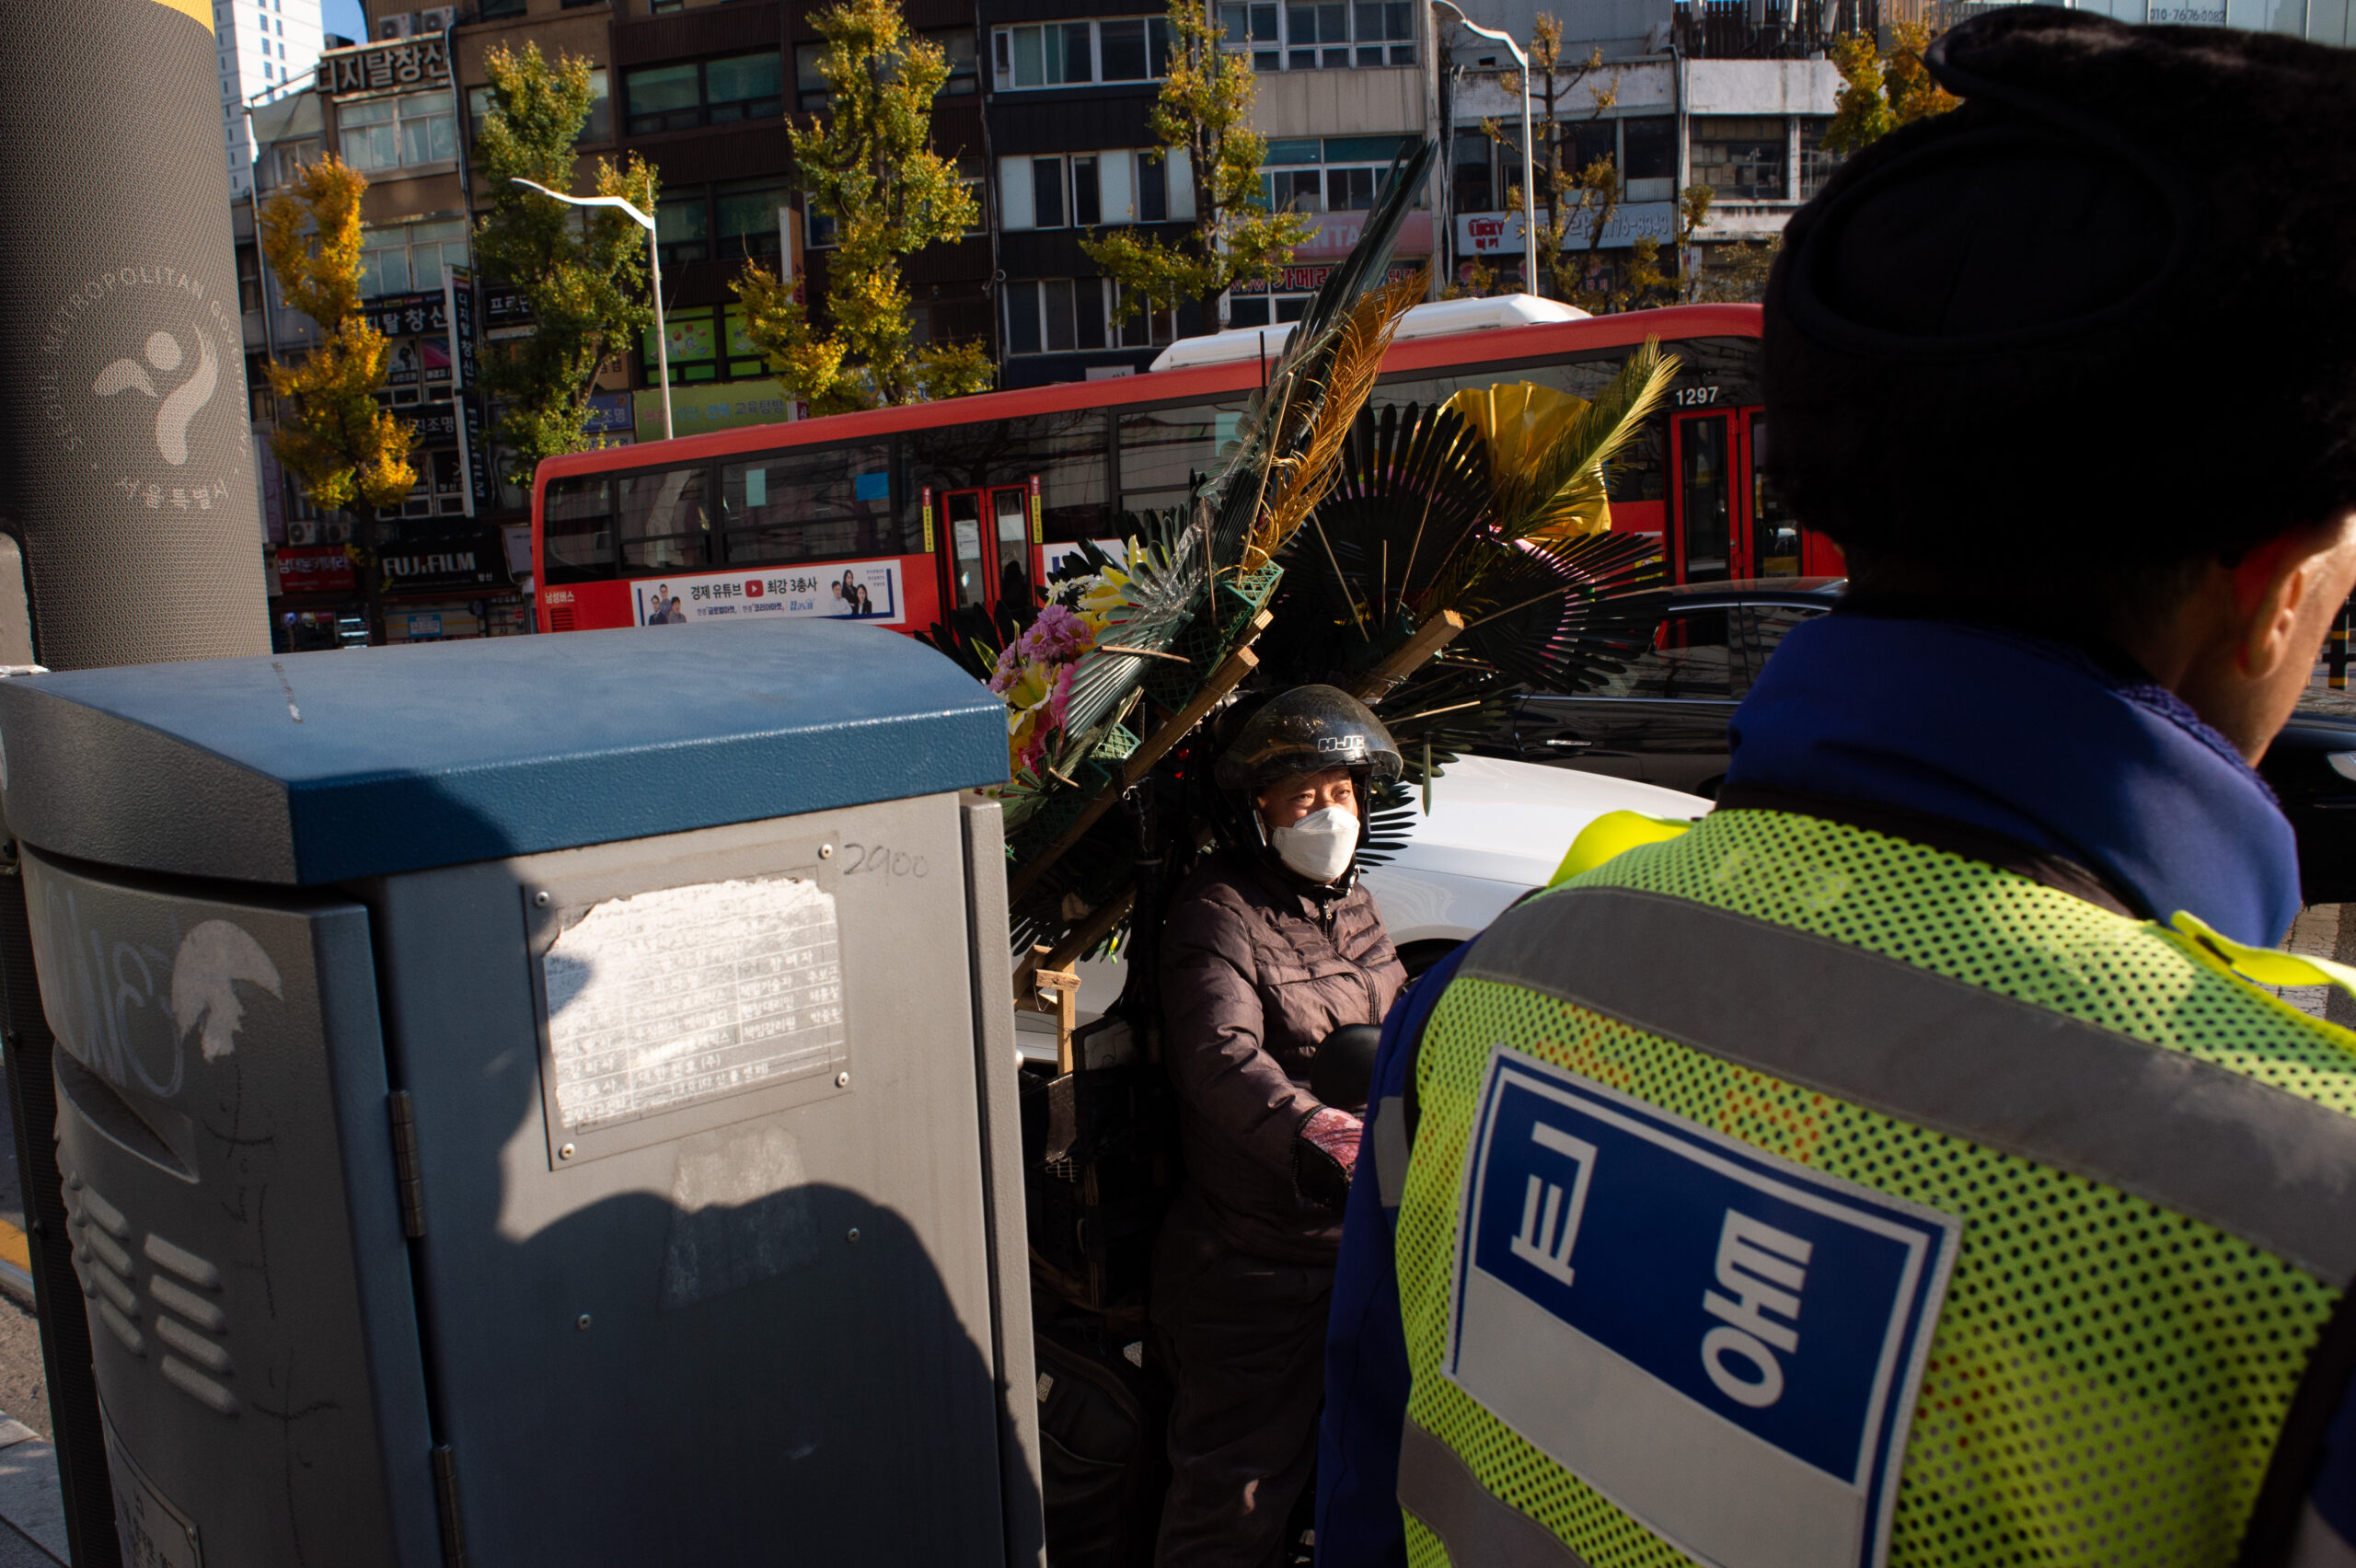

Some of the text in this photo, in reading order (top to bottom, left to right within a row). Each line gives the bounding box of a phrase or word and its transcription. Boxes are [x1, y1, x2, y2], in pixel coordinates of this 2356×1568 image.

[1469, 221, 1504, 236] LUCKY
[1676, 386, 1718, 406] 1297
[115, 476, 229, 512] 서울특별시
[383, 552, 476, 578] FUJIFILM
[545, 591, 574, 604] 남성버스
[691, 576, 817, 600] 경제 유튜브 최강 3총사
[1318, 734, 1364, 752] HJC
[701, 1053, 721, 1070] (주)
